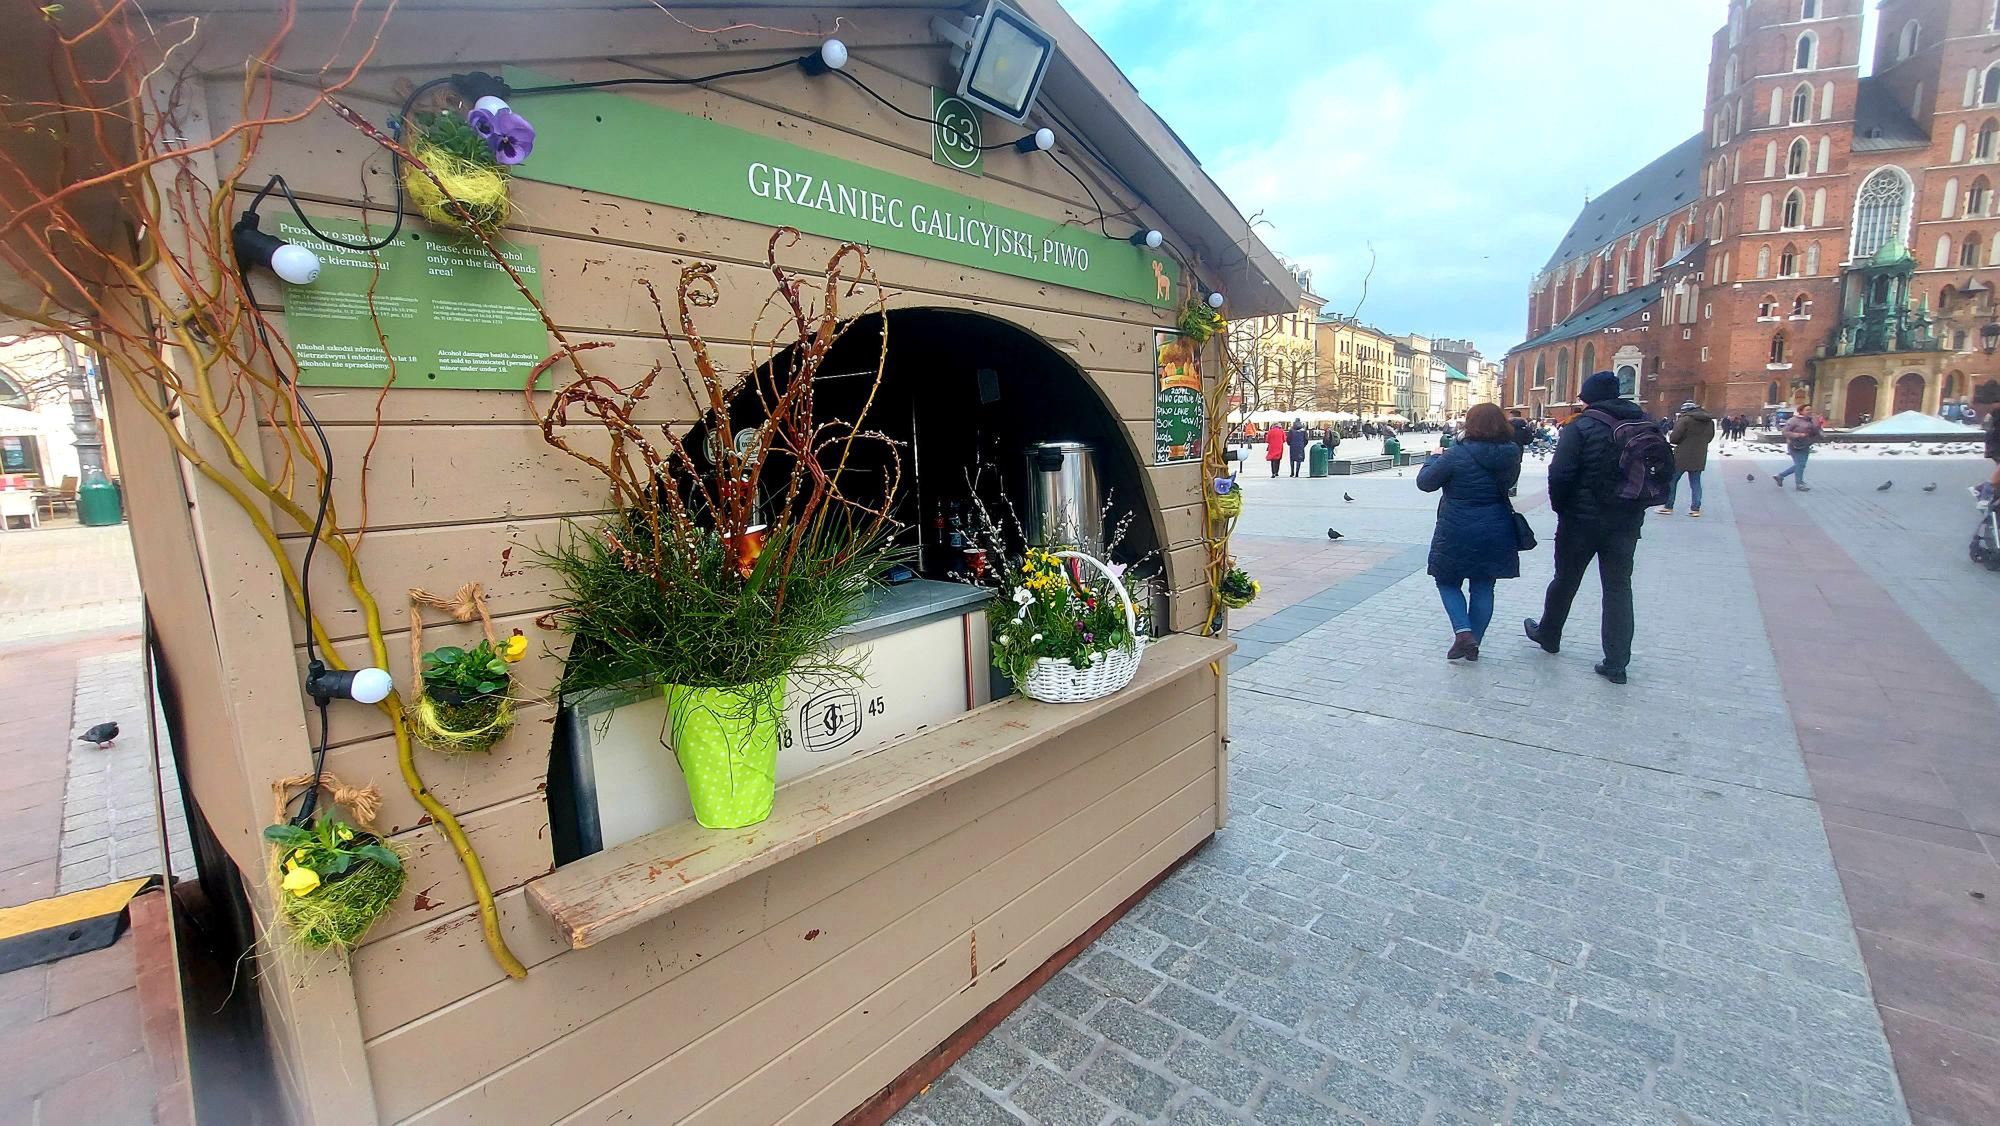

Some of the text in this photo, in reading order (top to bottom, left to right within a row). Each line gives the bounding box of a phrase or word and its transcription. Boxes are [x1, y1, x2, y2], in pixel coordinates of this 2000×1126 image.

[943, 114, 974, 152] 63
[748, 162, 1088, 271] GRZANIEC GALICYJSKI, PIWO
[280, 223, 328, 240] Prosiy
[282, 238, 333, 252] lkoholu
[426, 242, 460, 255] Please,
[462, 246, 488, 257] drink
[427, 255, 449, 266] only
[466, 258, 481, 268] the
[484, 260, 536, 274] fairgounds
[429, 268, 453, 277] area!
[868, 696, 886, 717] 45
